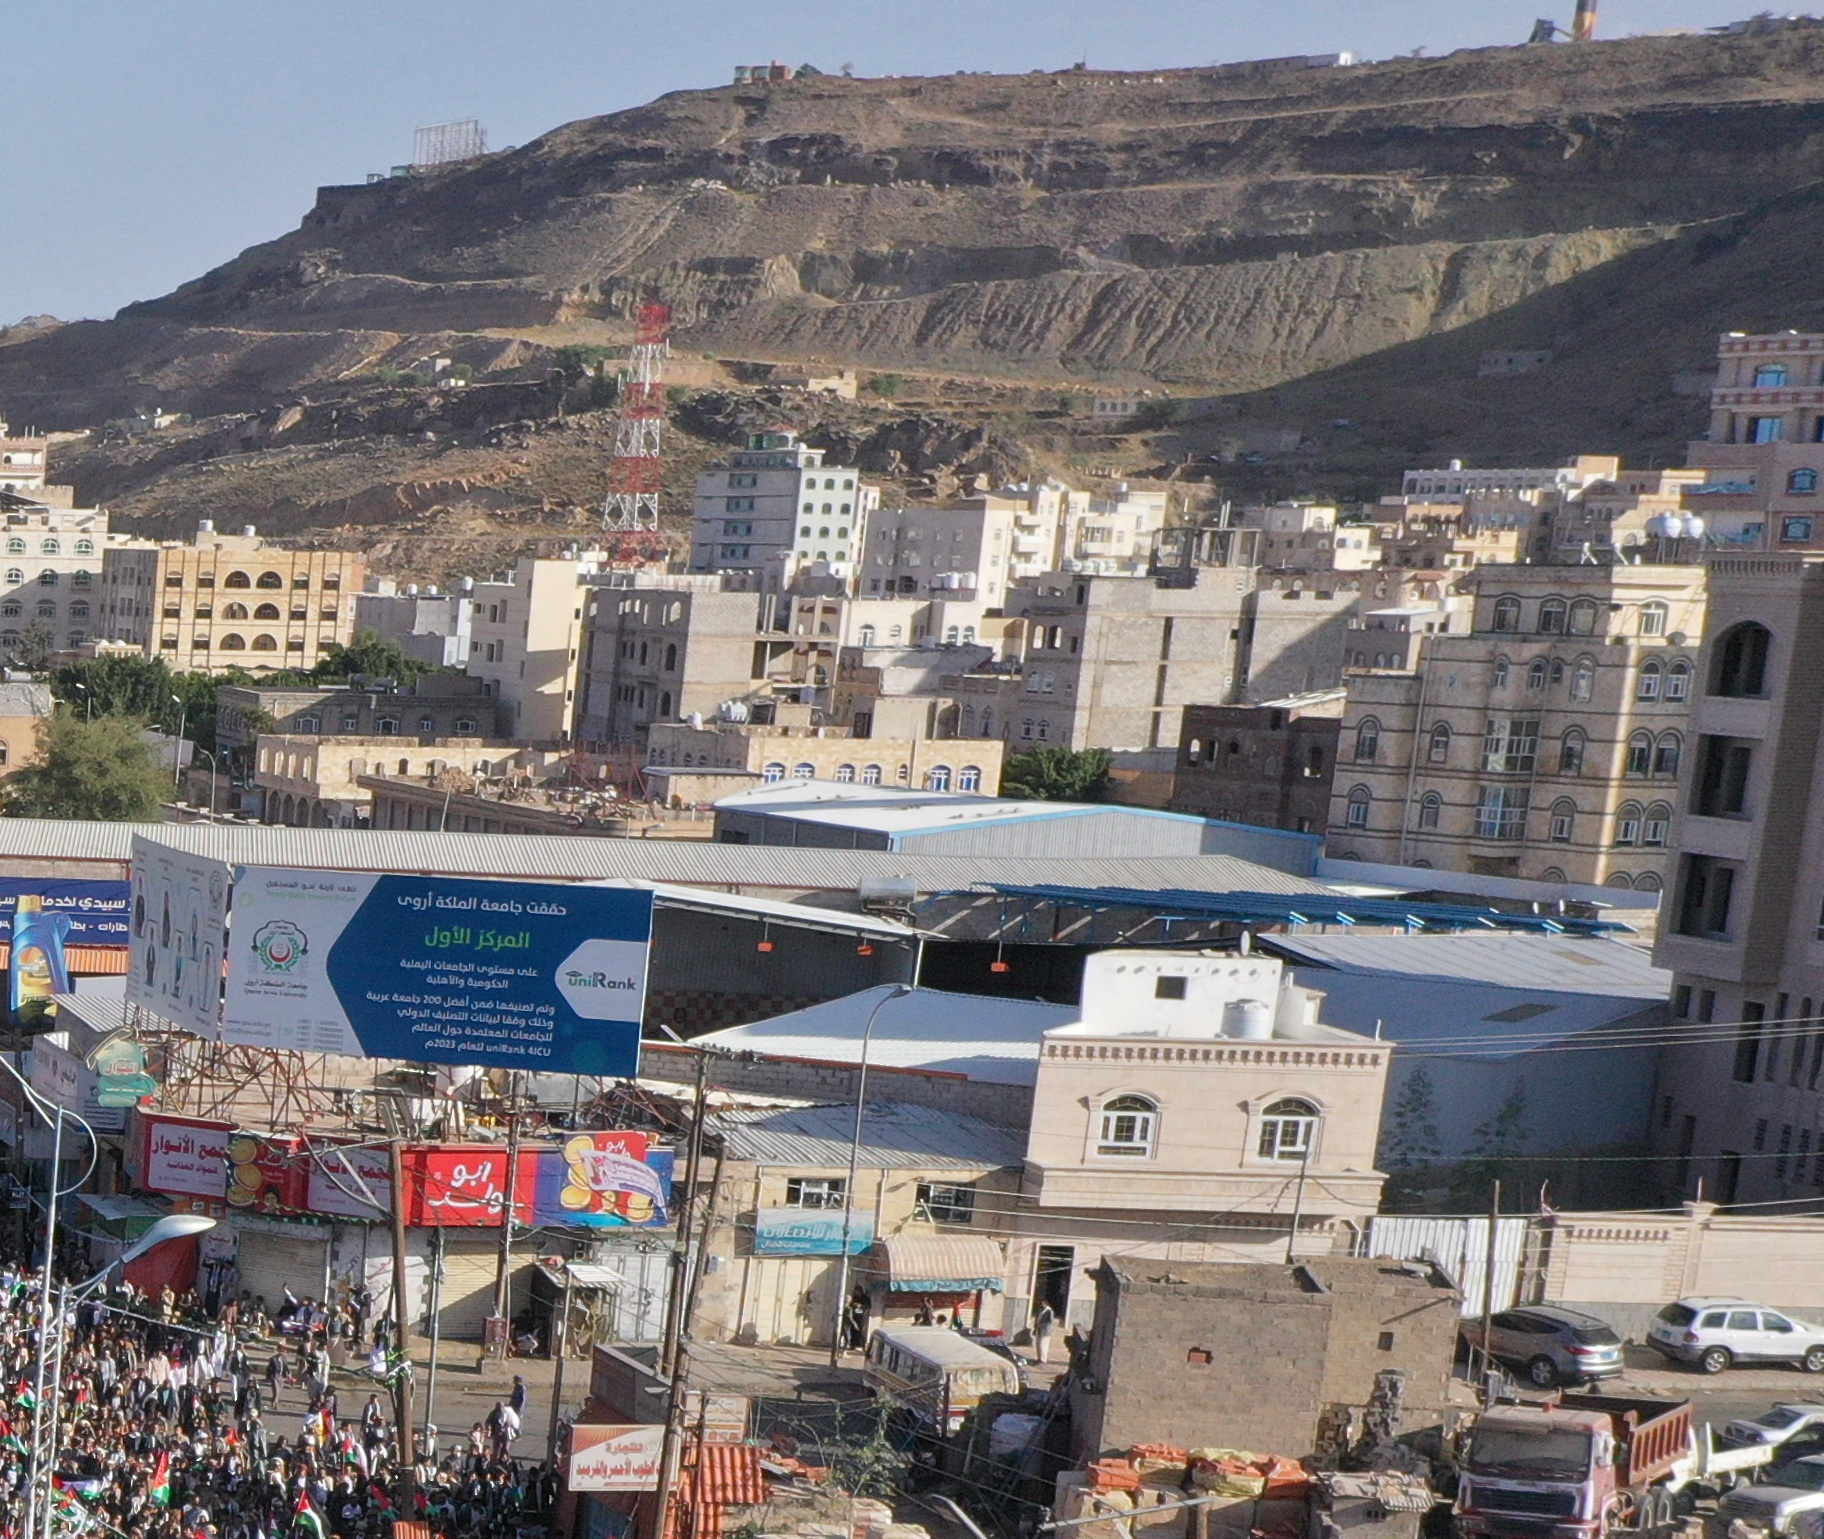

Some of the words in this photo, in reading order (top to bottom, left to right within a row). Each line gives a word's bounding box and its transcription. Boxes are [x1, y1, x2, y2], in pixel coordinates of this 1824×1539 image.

[41, 896, 77, 909] لخدما
[397, 891, 433, 910] أروى
[436, 896, 477, 910] الملكة
[480, 899, 522, 916] جامعة
[526, 902, 566, 916] حققت
[425, 926, 470, 947] الأول
[475, 929, 530, 951] المركز
[400, 958, 431, 969] اليمنية
[434, 961, 474, 973] الجامعات
[476, 965, 514, 977] مستوى
[517, 967, 538, 977] على
[426, 974, 465, 987] والأهلية
[467, 979, 508, 991] الحكومية
[568, 972, 636, 991] uniRank
[366, 990, 390, 1003] عربية
[392, 993, 421, 1005] جامعة
[423, 995, 441, 1004] 200
[443, 995, 469, 1008] أفضل
[470, 1000, 494, 1011] ضمن
[496, 1002, 533, 1012] تصنيفها
[536, 1004, 555, 1016] وتم
[397, 1007, 430, 1020] الدولي
[432, 1009, 468, 1021] التصنيف
[470, 1013, 500, 1024] لبيانات
[412, 1023, 441, 1034] العالم
[528, 1017, 554, 1029] وذلك
[442, 1025, 462, 1037] حول
[464, 1026, 508, 1038] المعتمدة
[510, 1030, 553, 1042] للجامعات
[457, 1040, 484, 1051] للعام
[151, 1134, 194, 1155] الأنوار
